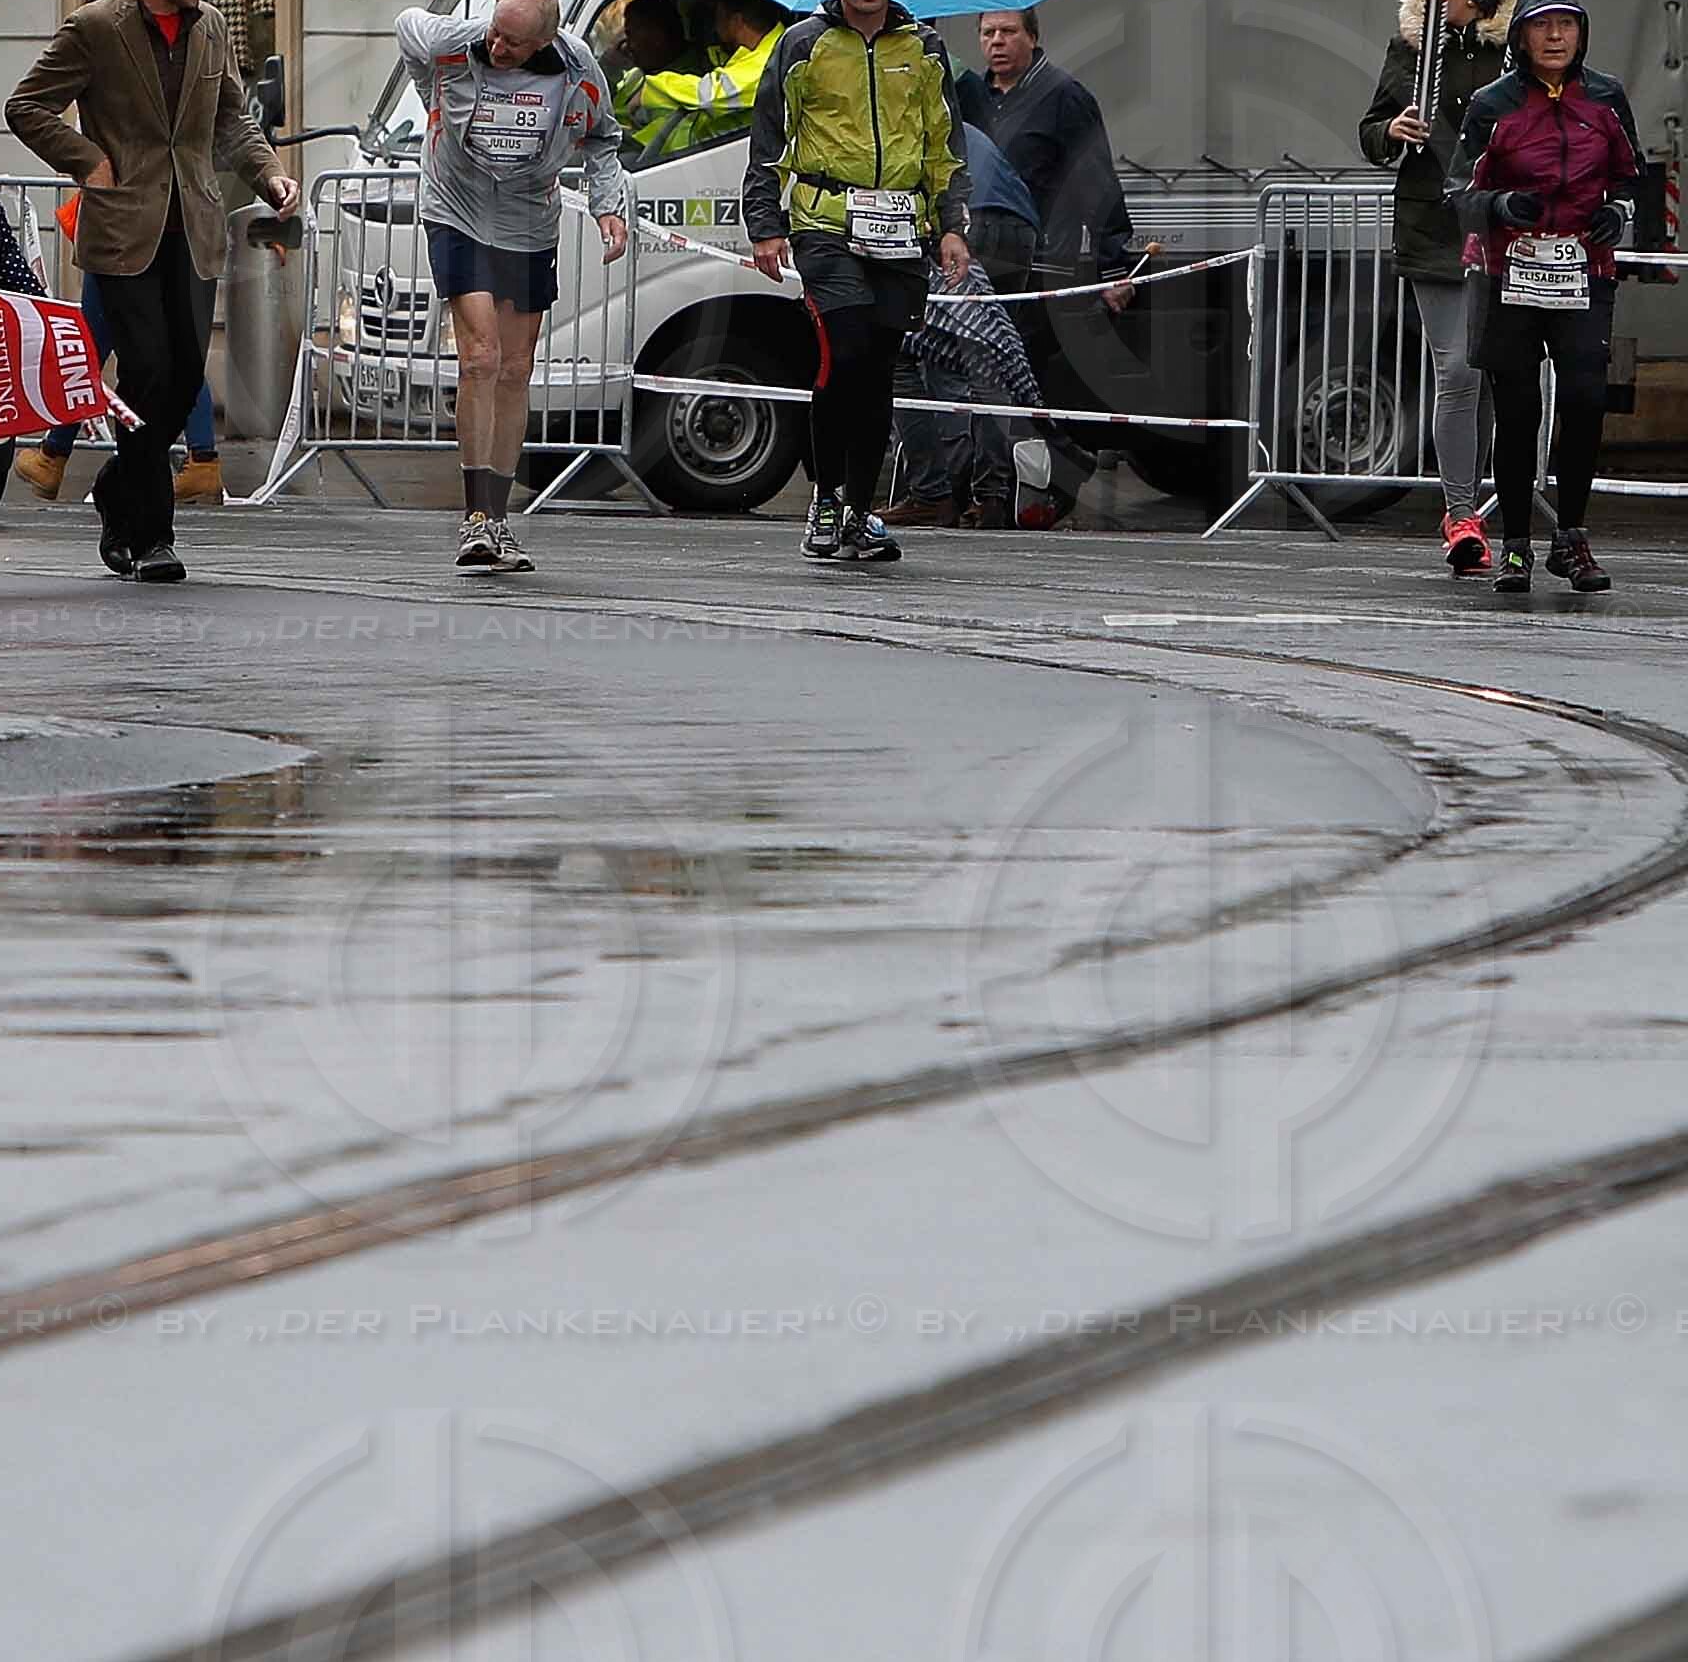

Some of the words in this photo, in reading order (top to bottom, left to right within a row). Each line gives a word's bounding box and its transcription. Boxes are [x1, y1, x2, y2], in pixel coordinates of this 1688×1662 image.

[515, 111, 537, 127] 83
[487, 138, 521, 149] JULIUS
[637, 202, 736, 225] GRAZ
[1519, 270, 1574, 284] ELISABETH
[48, 315, 95, 410] KLEINE
